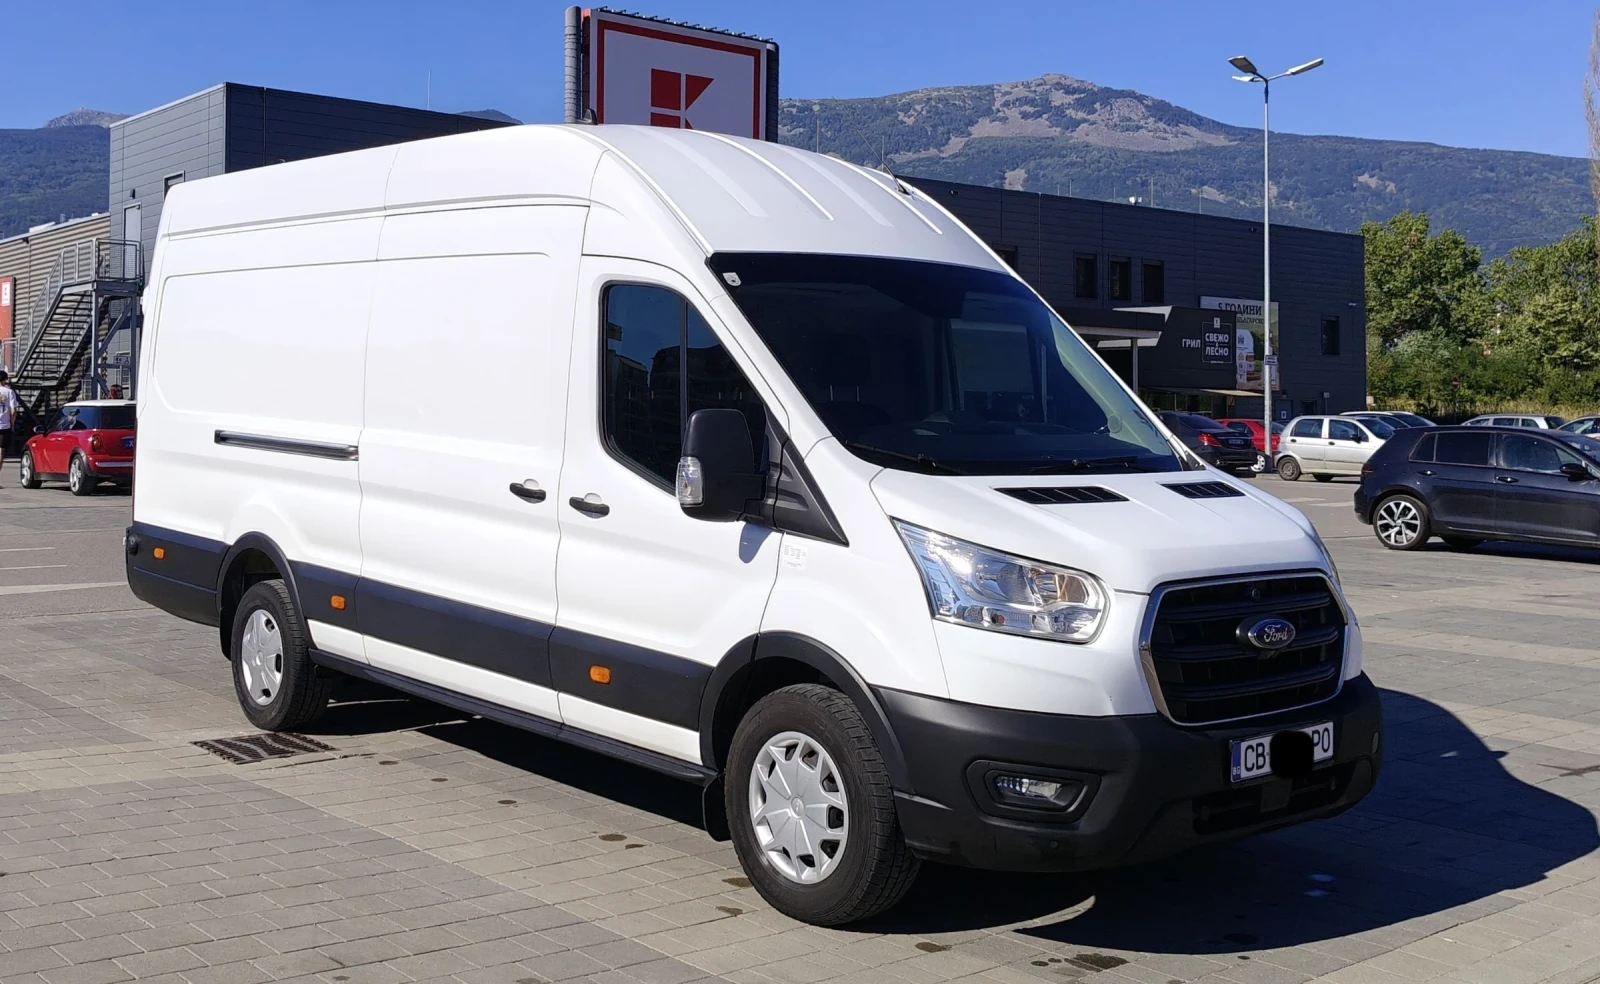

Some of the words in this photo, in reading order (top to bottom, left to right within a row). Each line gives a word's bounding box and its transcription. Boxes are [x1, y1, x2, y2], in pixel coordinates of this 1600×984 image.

[1225, 303, 1262, 315] ГОДИНИ
[1205, 333, 1229, 342] СВЕЖО
[1182, 338, 1201, 348] ГРИЛ
[1205, 347, 1229, 356] ЛЕСНО
[1264, 624, 1289, 643] Ford
[1232, 765, 1241, 775] BG
